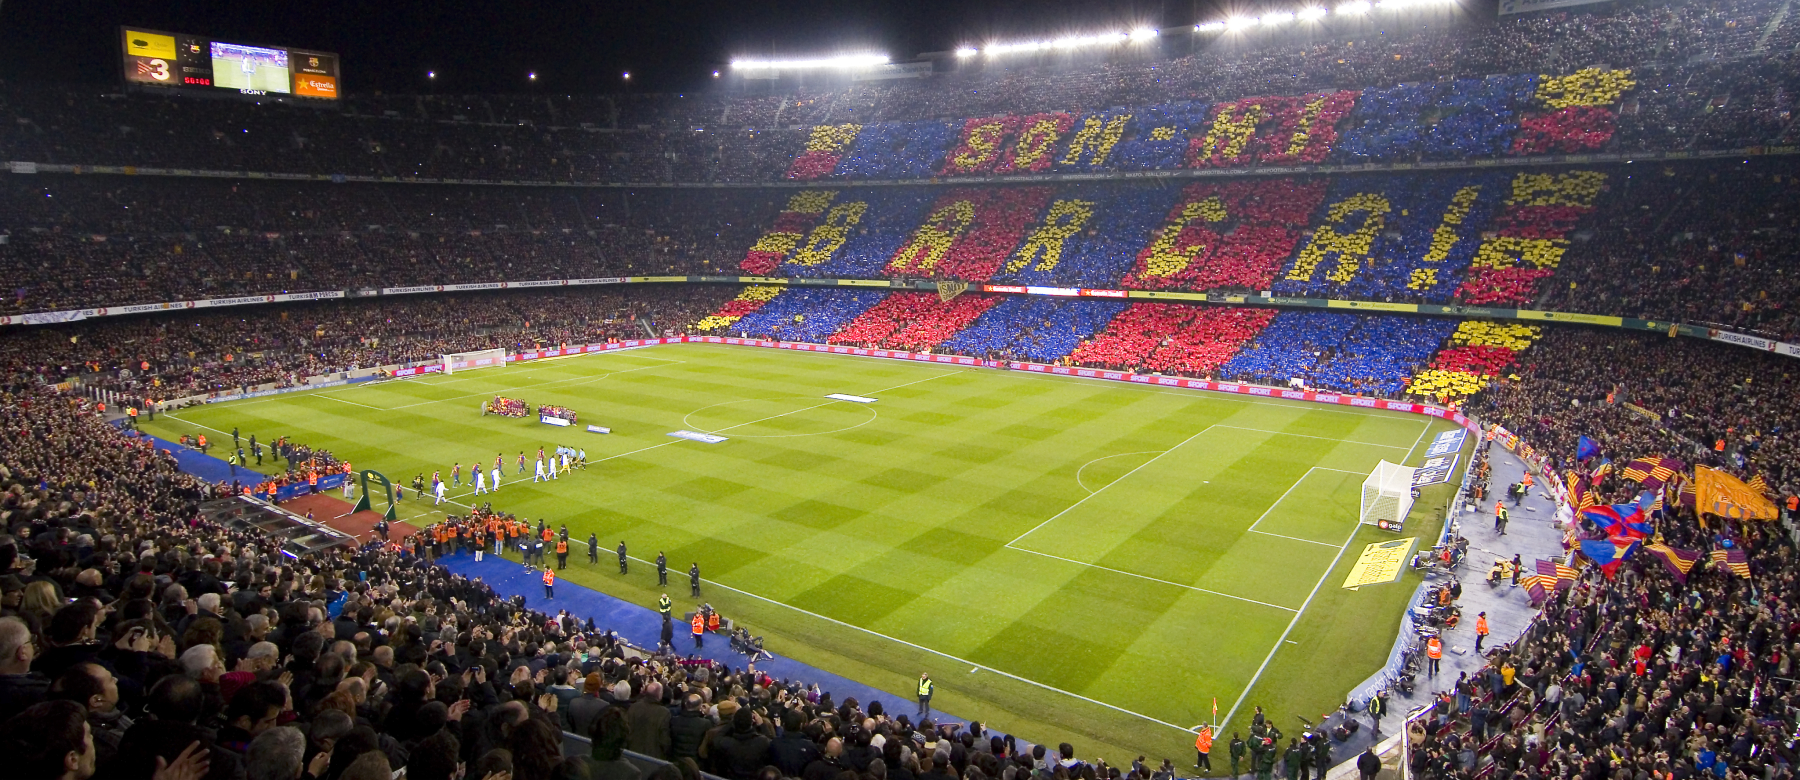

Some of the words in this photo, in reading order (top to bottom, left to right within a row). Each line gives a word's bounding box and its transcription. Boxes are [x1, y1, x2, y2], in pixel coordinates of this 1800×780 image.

[240, 88, 266, 96] SONY
[1718, 332, 1741, 343] TURKISH
[1742, 336, 1766, 348] AIRLINES
[523, 352, 538, 360] SPORT
[476, 358, 492, 366] SPORT
[396, 368, 416, 376] SPORT
[424, 364, 442, 372] SPORT
[1028, 364, 1045, 372] SPORT
[1052, 366, 1070, 374] SPORT
[1104, 372, 1122, 380] SPORT
[1158, 378, 1178, 386] SPORT
[1188, 381, 1208, 389] SPORT
[1218, 384, 1240, 392] SPORT
[1249, 387, 1271, 395] SPORT
[1282, 391, 1304, 399] SPORT
[1315, 394, 1339, 403] SPORT
[1350, 398, 1376, 407] SPORT
[1387, 402, 1413, 412] SPORT
[1423, 406, 1446, 417] SPORT
[1388, 522, 1402, 530] galp
